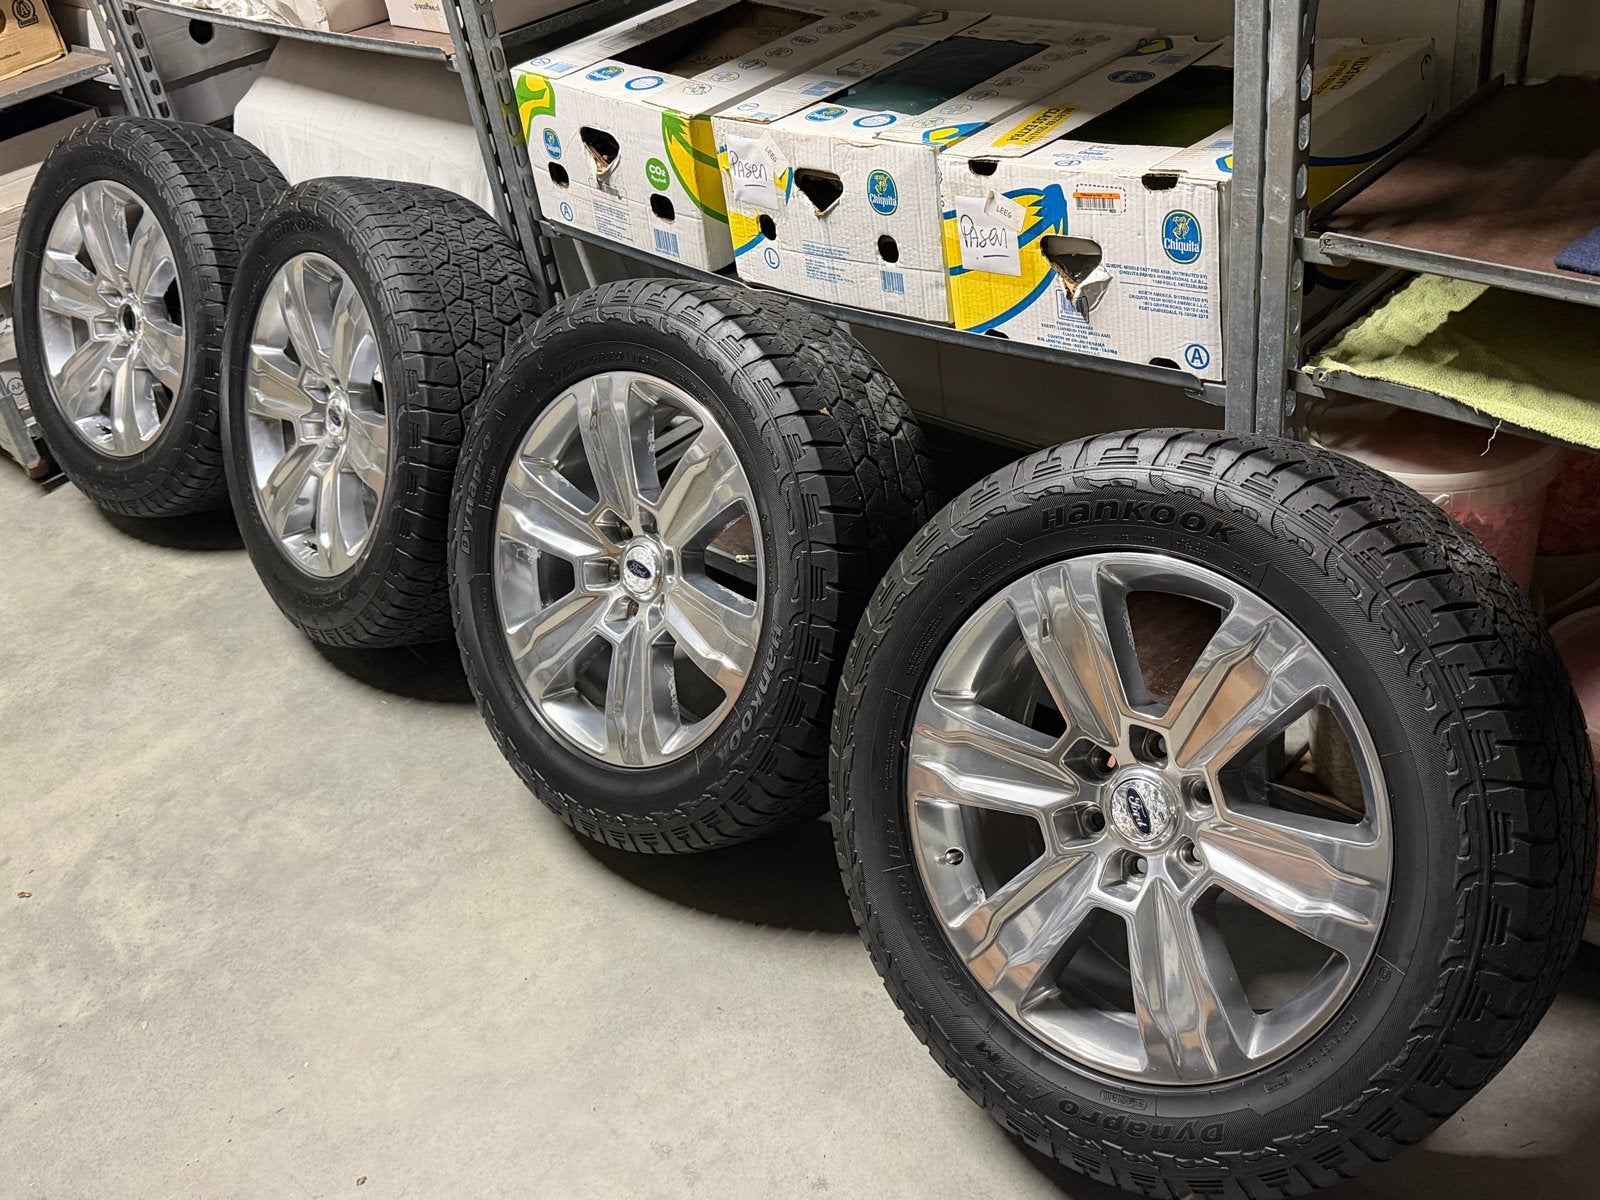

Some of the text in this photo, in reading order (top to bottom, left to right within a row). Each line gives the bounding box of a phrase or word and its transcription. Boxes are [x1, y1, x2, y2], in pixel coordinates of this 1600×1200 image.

[1006, 108, 1060, 140] CLASS EXTRA
[765, 146, 778, 162] LEEG
[869, 192, 897, 207] Chiquita
[996, 204, 1012, 218] LEEG
[1164, 237, 1200, 254] Chiquita
[460, 432, 491, 554] Dynapro
[1041, 500, 1242, 545] Hankook
[715, 620, 784, 767] Hankook
[1058, 1100, 1227, 1145] Dynapro
